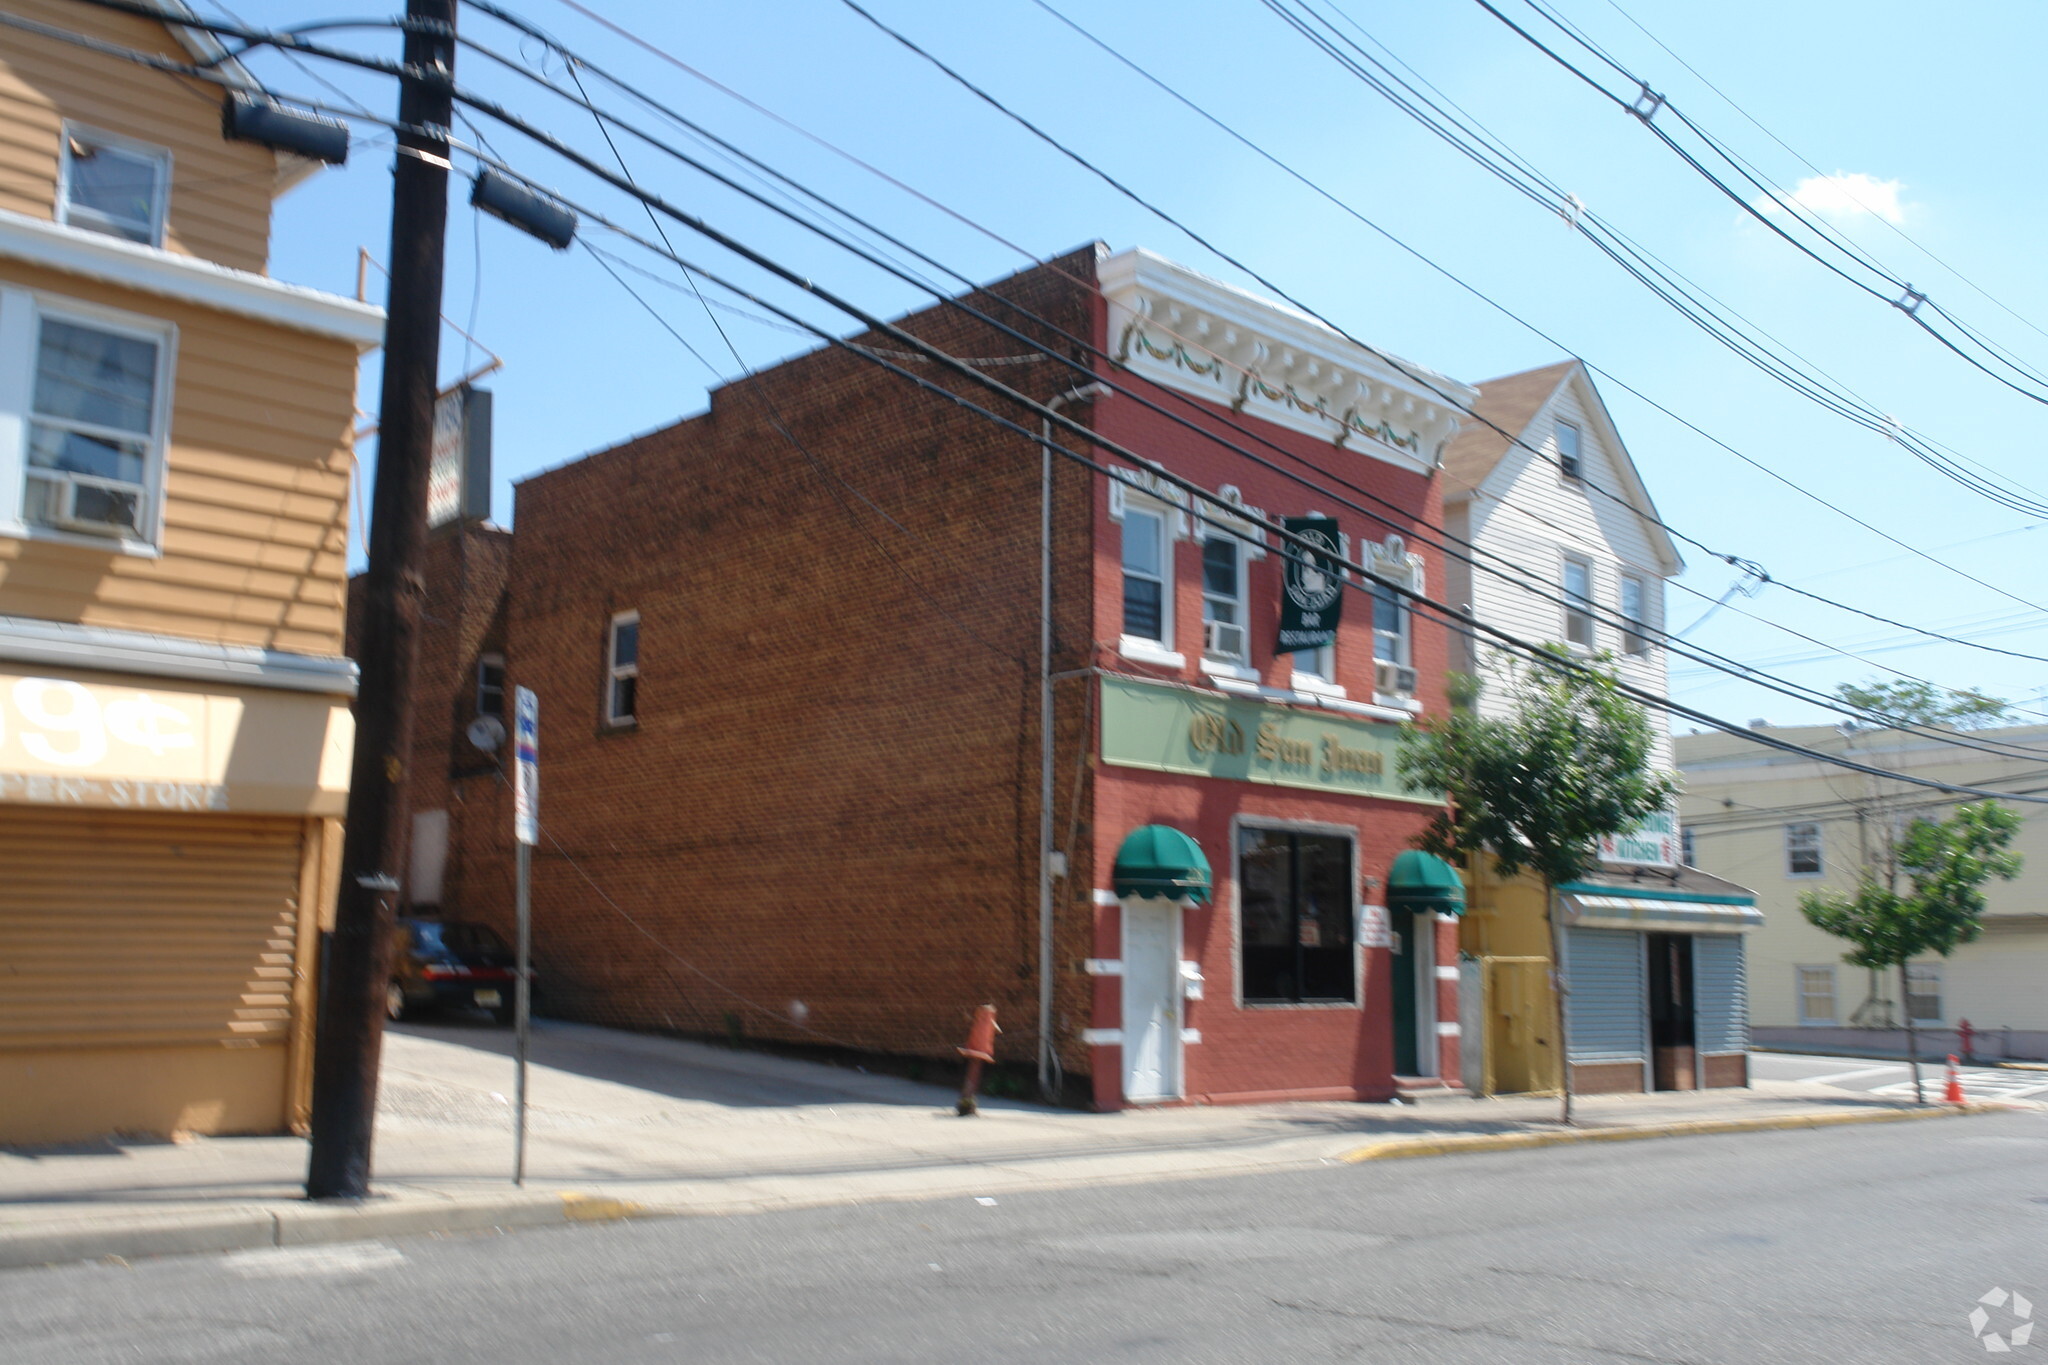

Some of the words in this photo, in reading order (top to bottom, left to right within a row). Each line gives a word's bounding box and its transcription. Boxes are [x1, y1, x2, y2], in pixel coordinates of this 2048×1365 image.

[1190, 712, 1245, 757] Old
[1256, 722, 1313, 765] San
[1320, 733, 1384, 775] Juan
[1615, 836, 1660, 862] KITCHEN
